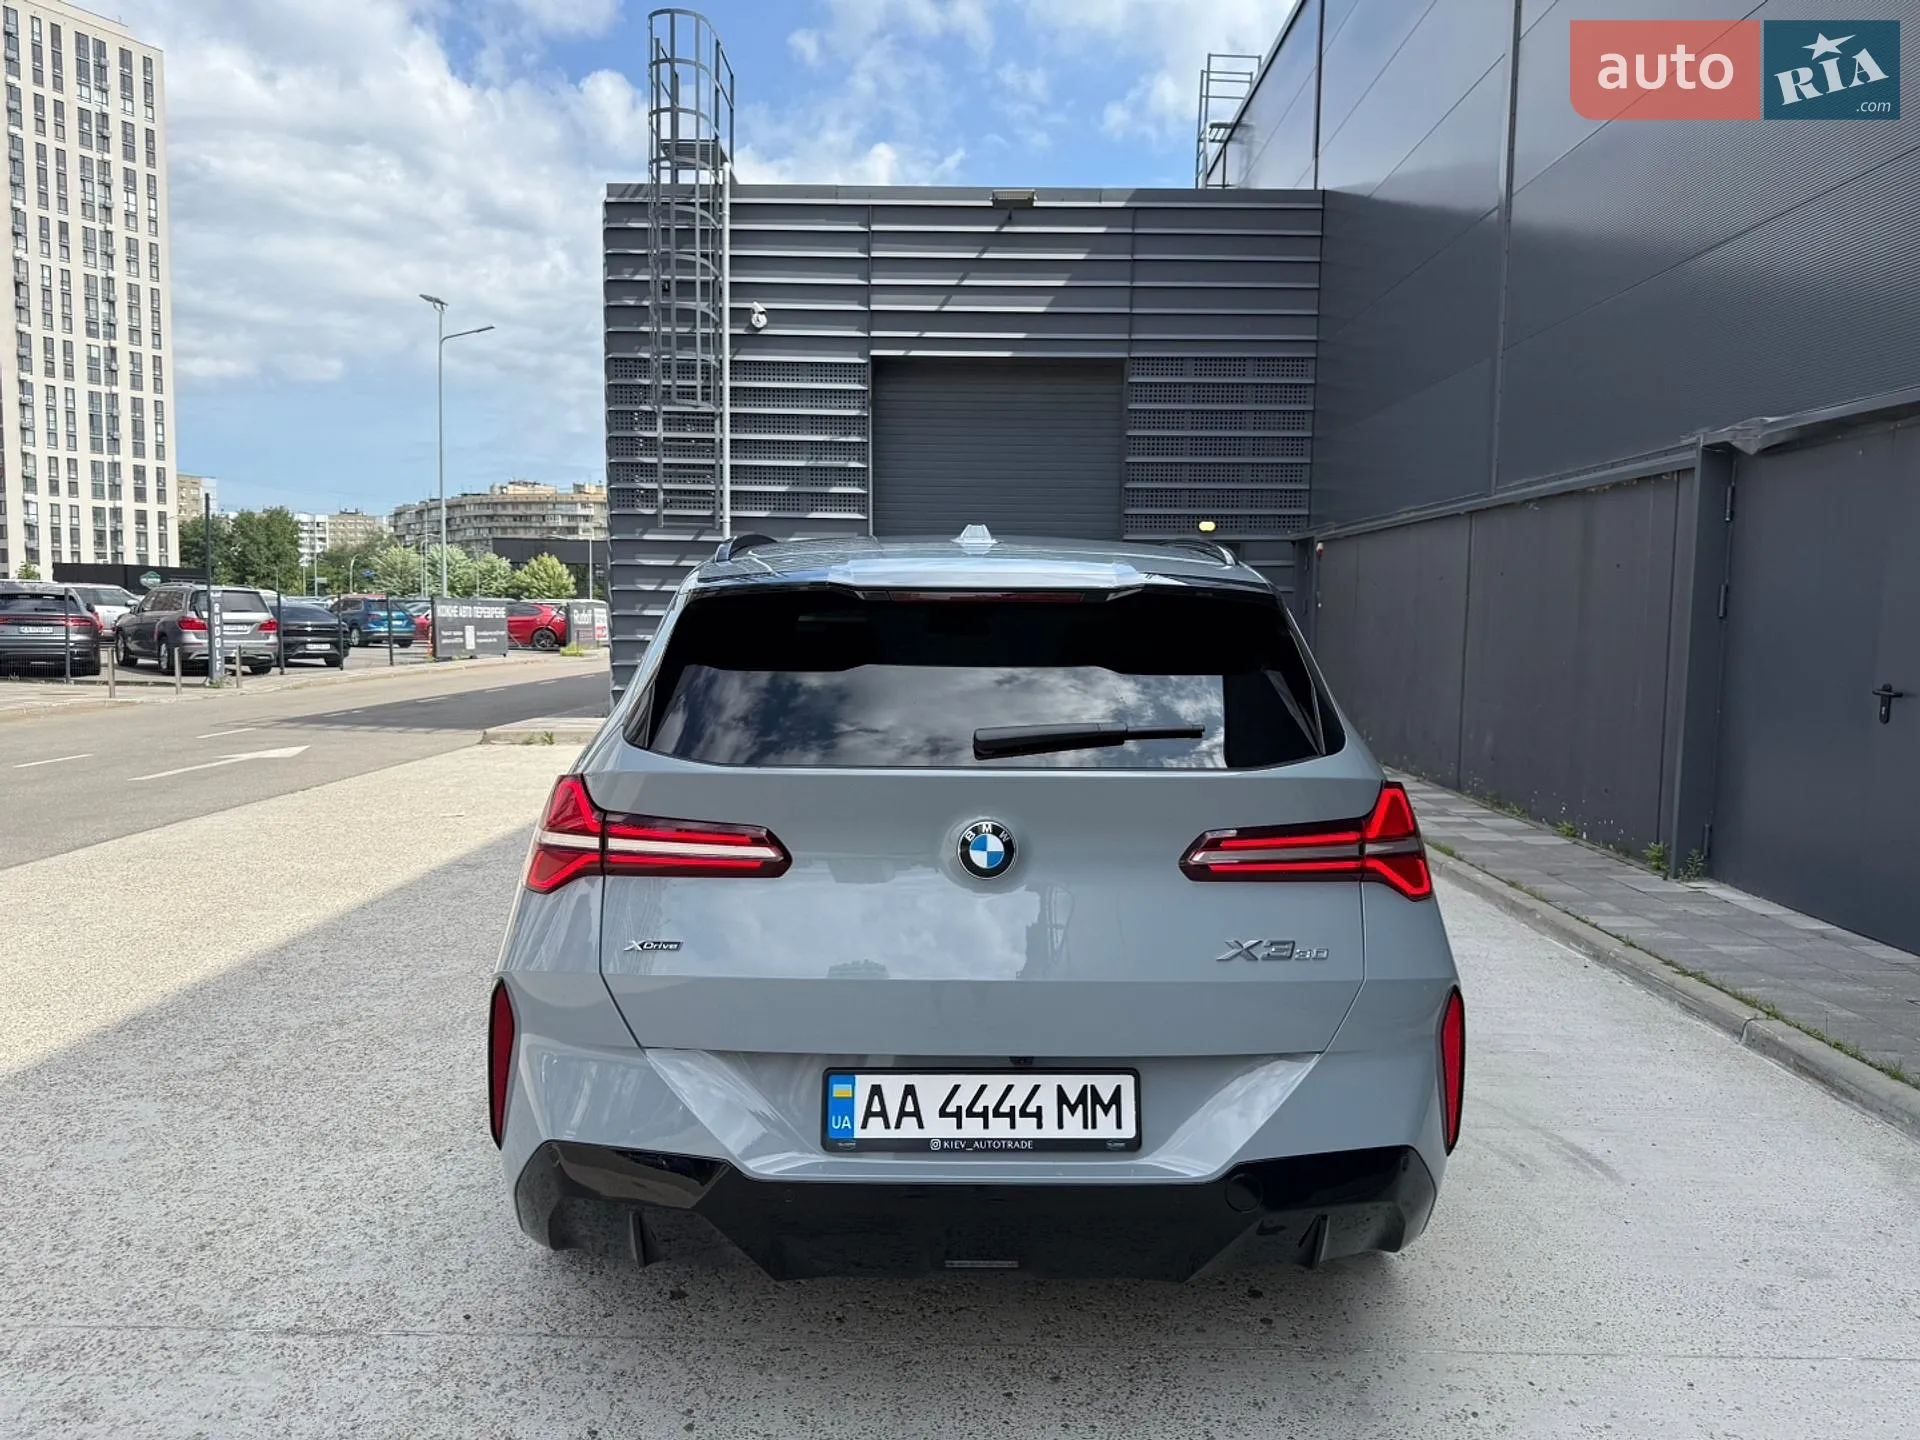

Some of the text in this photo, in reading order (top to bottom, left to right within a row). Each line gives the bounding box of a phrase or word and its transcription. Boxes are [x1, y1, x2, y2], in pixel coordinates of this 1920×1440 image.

[965, 823, 1011, 842] BMW
[860, 1083, 1122, 1130] AA 4444 MM
[831, 1115, 852, 1130] UA
[943, 1139, 1034, 1151] KIEV_AUTOTRADE
